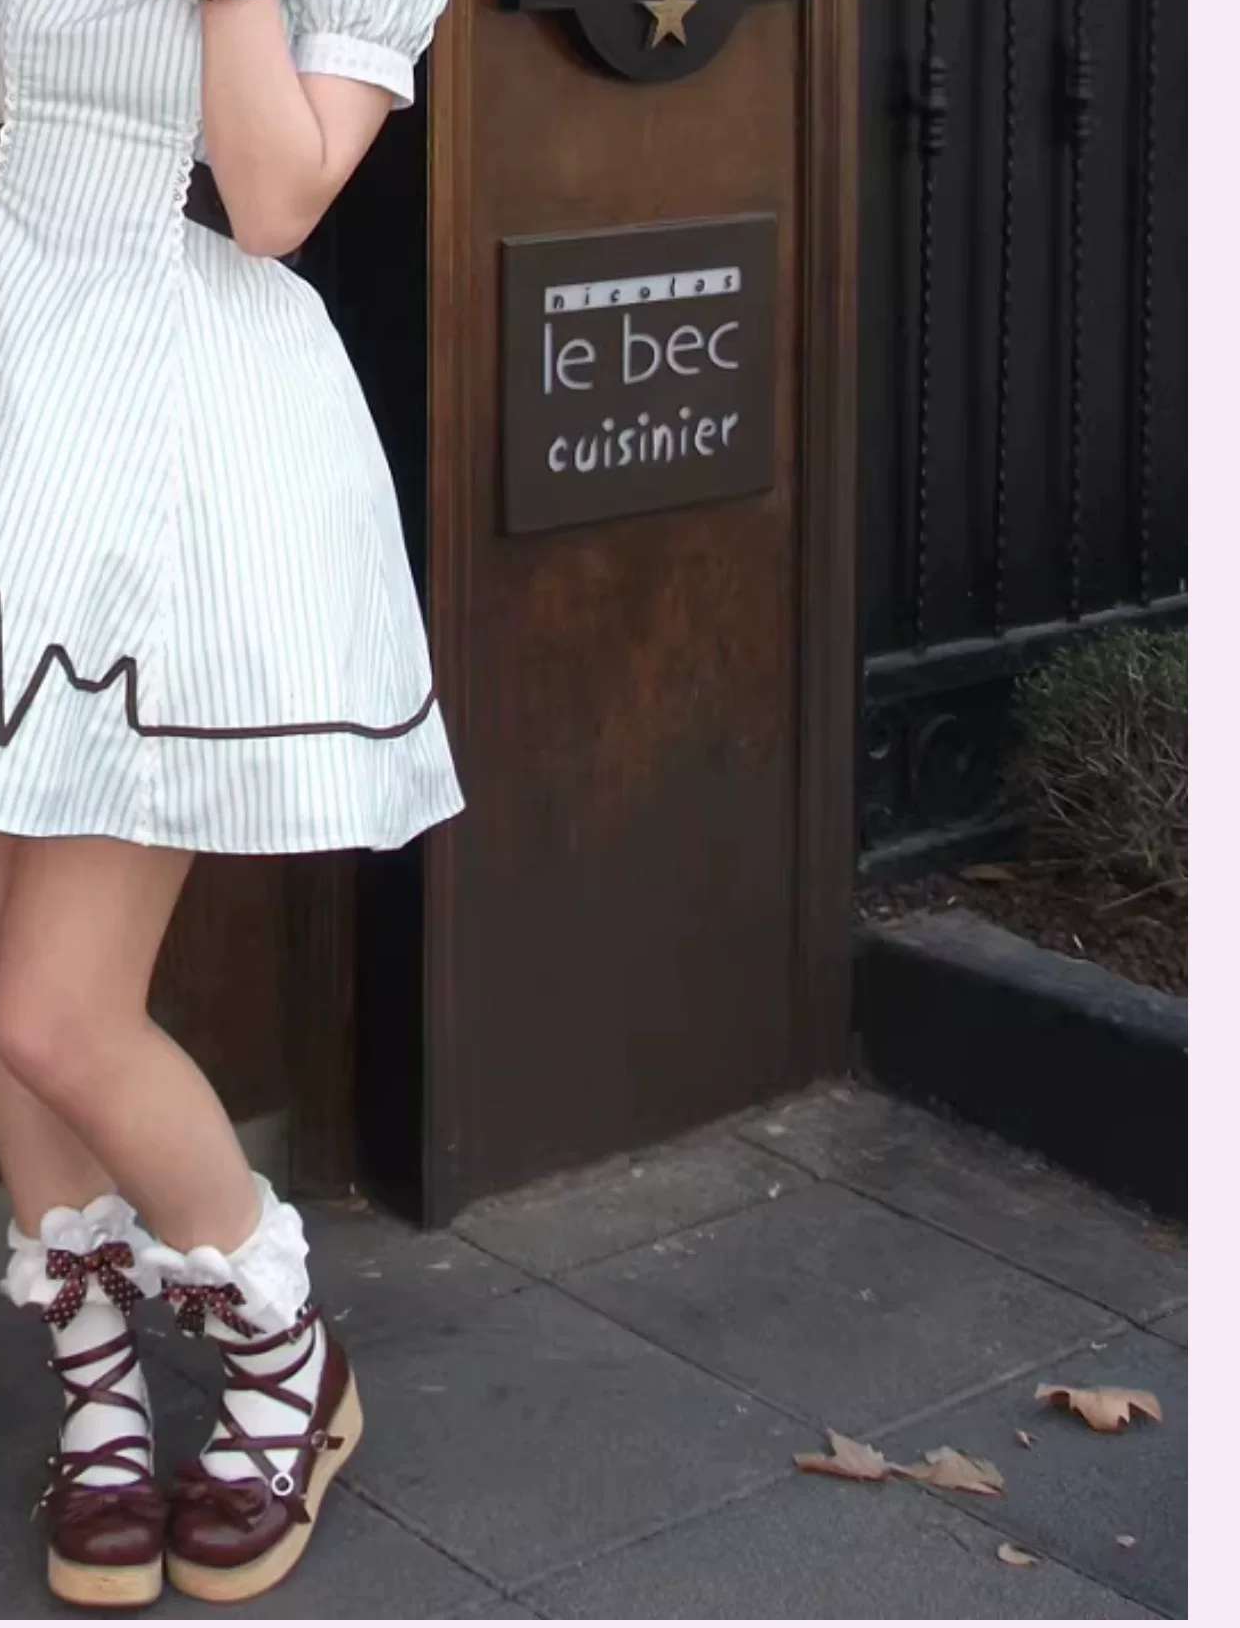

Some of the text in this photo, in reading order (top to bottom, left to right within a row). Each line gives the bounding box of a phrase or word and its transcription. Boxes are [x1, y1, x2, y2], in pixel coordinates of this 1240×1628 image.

[551, 273, 734, 310] nicolas
[544, 312, 740, 395] le bec
[547, 406, 739, 473] cuisinier
